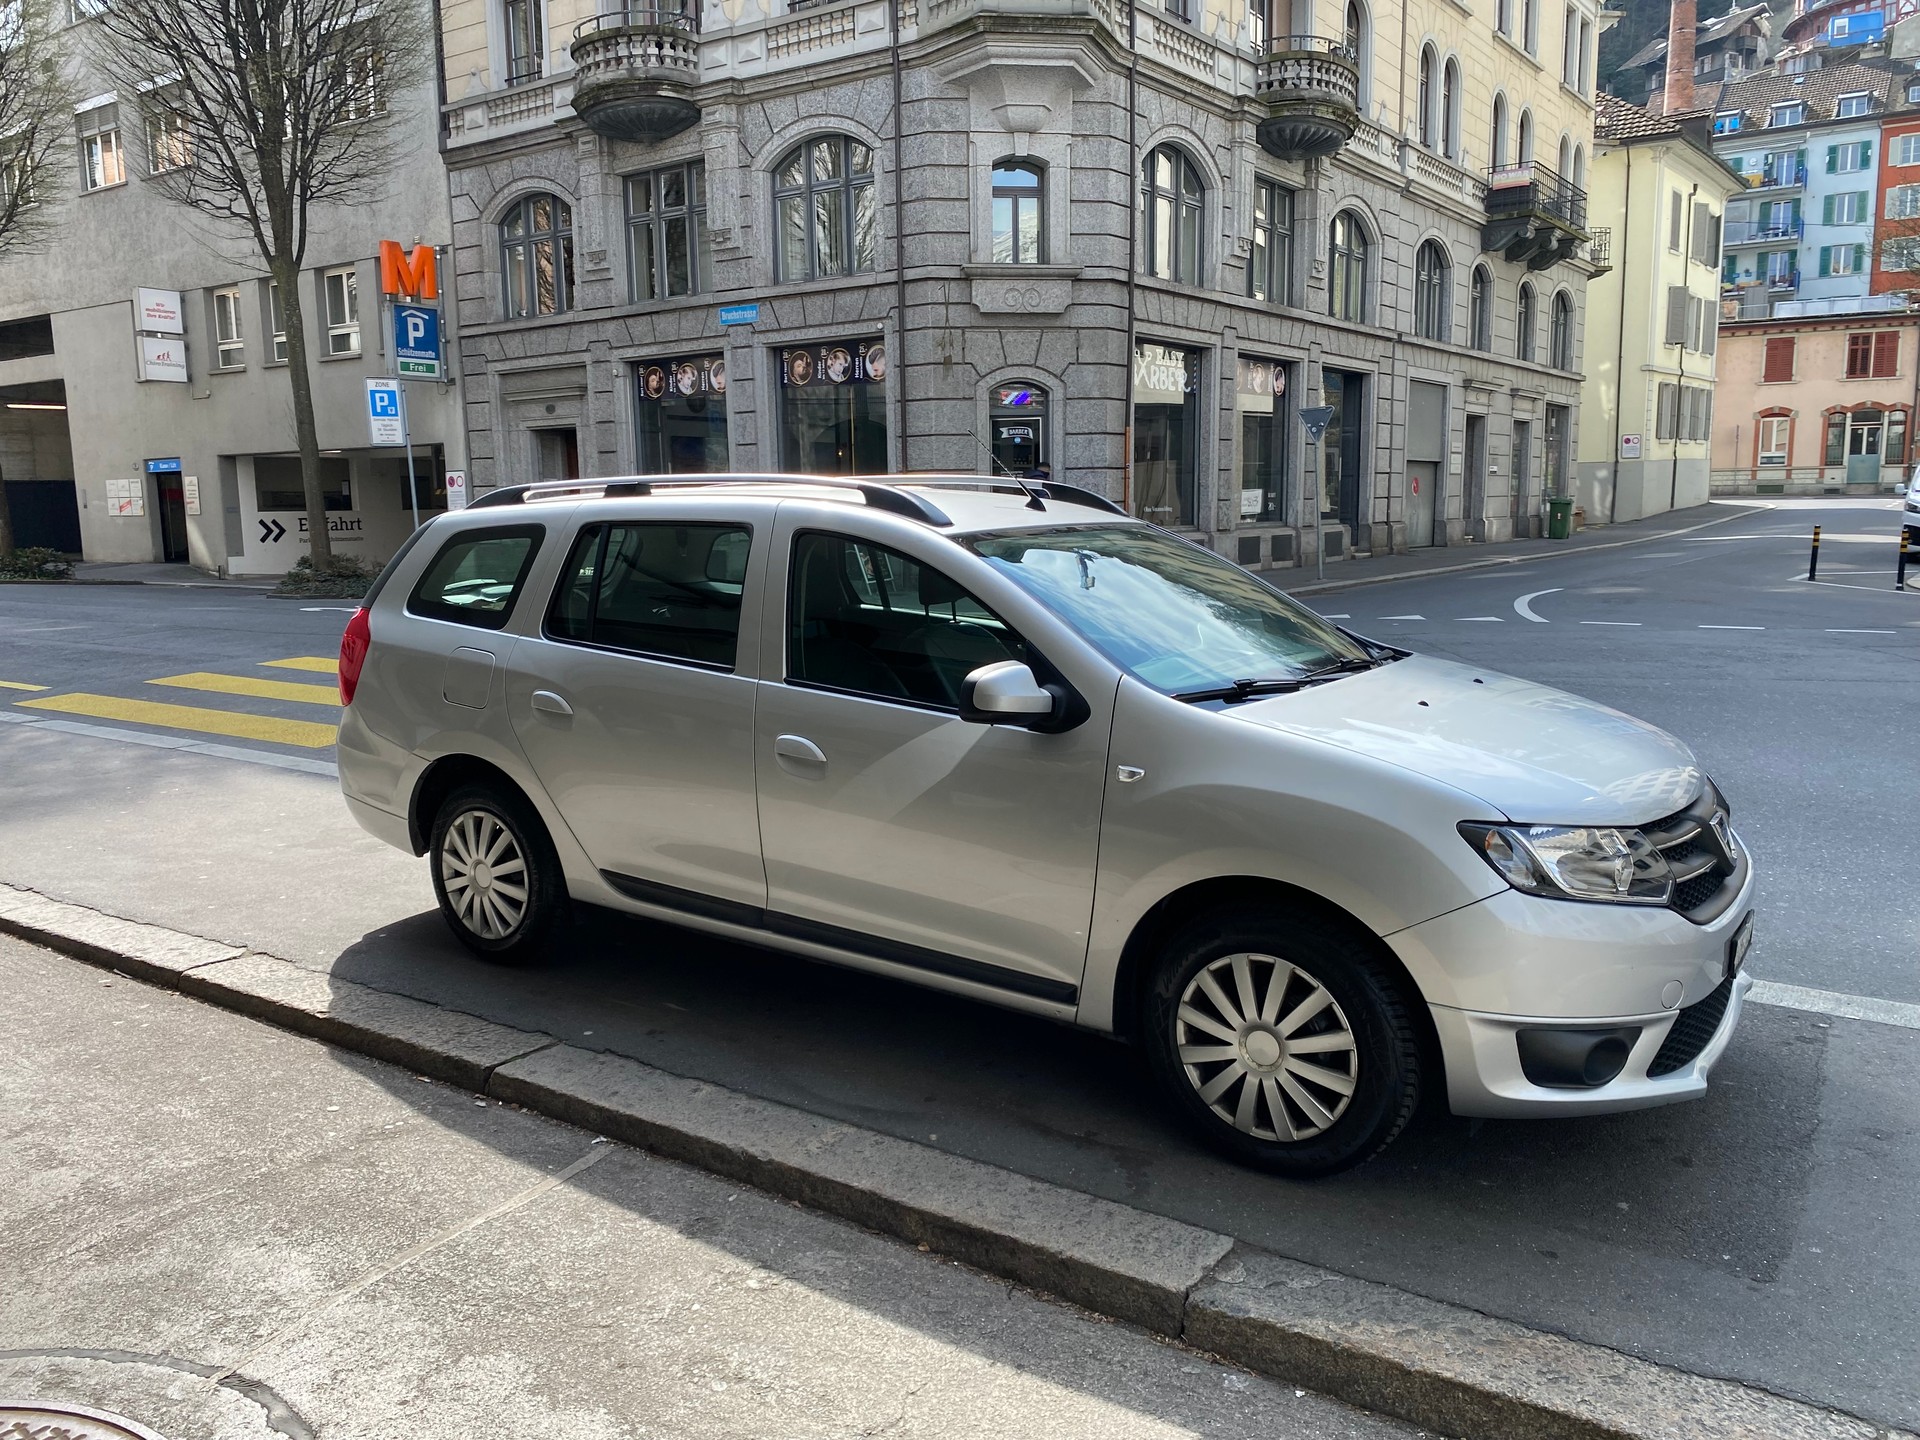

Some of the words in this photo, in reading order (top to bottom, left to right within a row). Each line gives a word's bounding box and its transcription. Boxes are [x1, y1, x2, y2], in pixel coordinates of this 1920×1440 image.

[379, 240, 437, 299] M
[721, 310, 757, 320] Bruchstrasse
[407, 317, 425, 347] P
[397, 347, 436, 358] Schützenmatte
[1155, 348, 1185, 368] EASY
[409, 363, 427, 372] Frei
[375, 392, 389, 413] P
